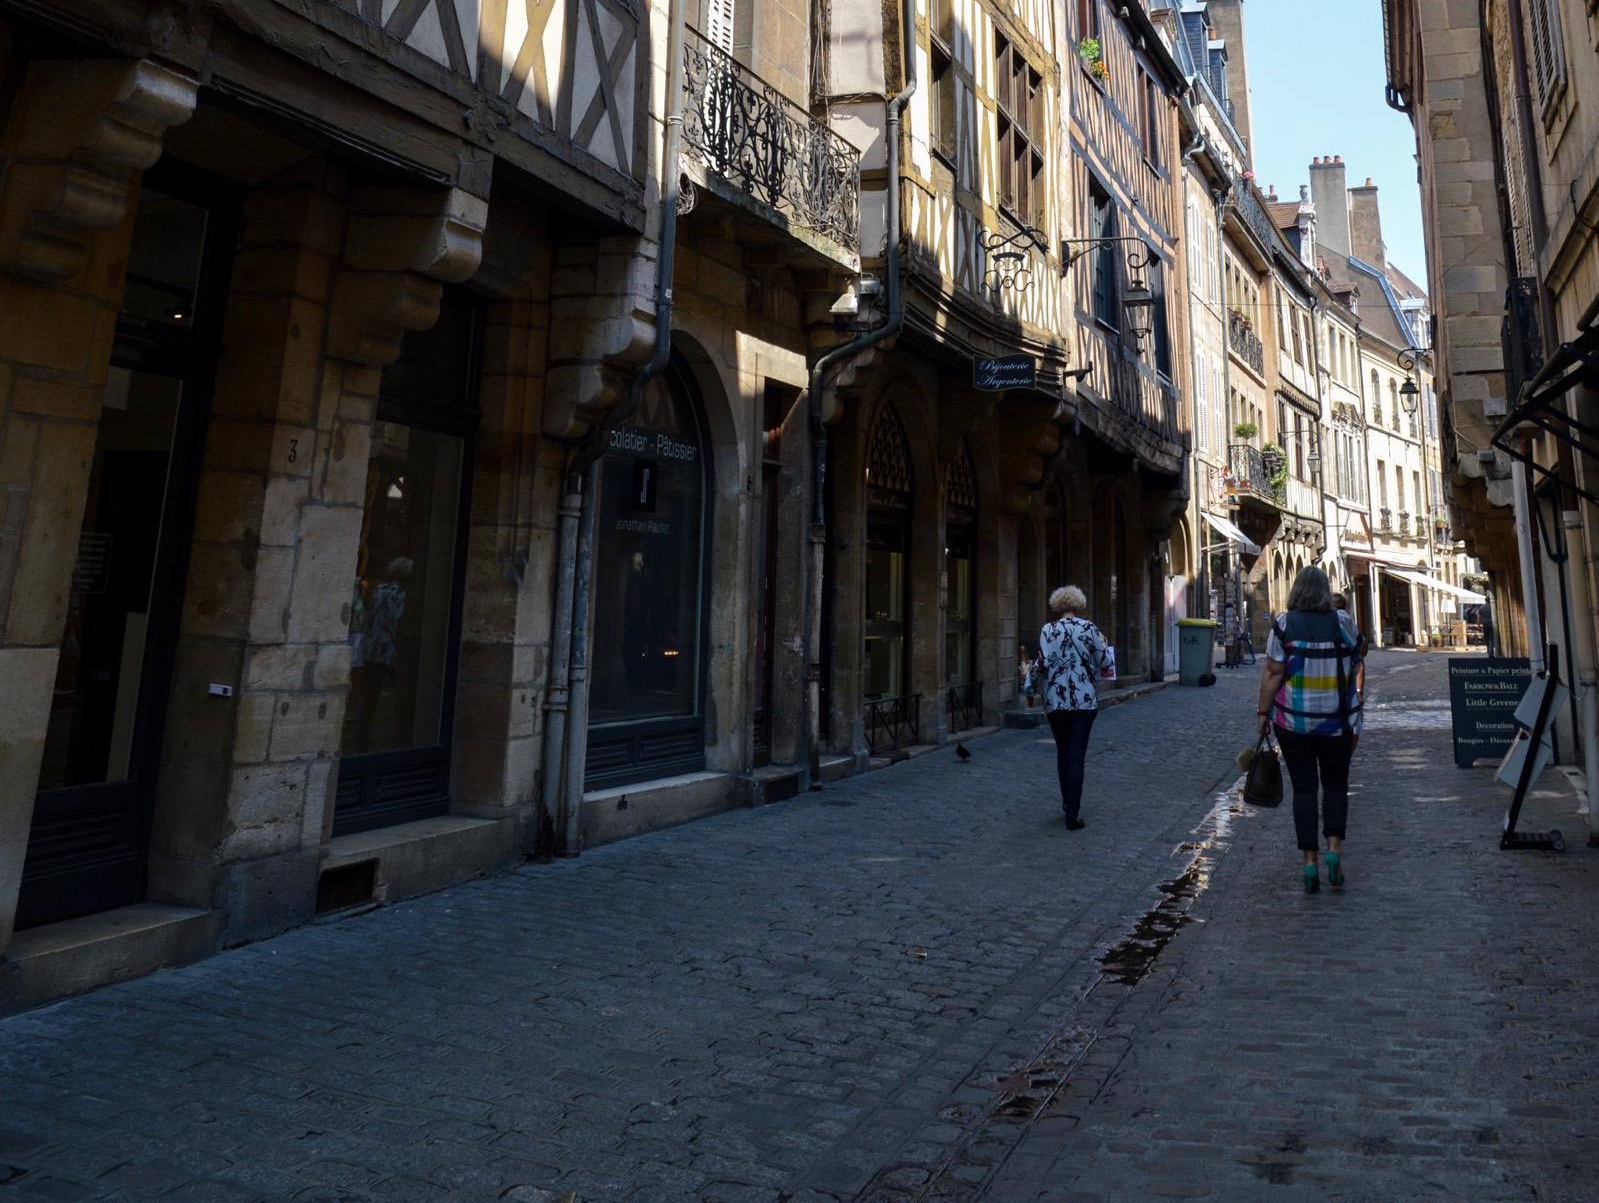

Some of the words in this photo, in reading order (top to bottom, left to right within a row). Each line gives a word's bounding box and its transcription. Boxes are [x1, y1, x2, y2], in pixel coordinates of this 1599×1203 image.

[980, 360, 1029, 375] Bijouterie
[977, 374, 1032, 389] Argenterie
[288, 439, 298, 463] 3
[657, 434, 697, 461] Pâtissier
[616, 518, 647, 532] Jonathan
[1487, 667, 1510, 676] Papier
[1466, 698, 1487, 707] Little
[1489, 698, 1519, 707] Greene
[1476, 721, 1514, 729] Décoration
[1458, 737, 1484, 745] Bougies
